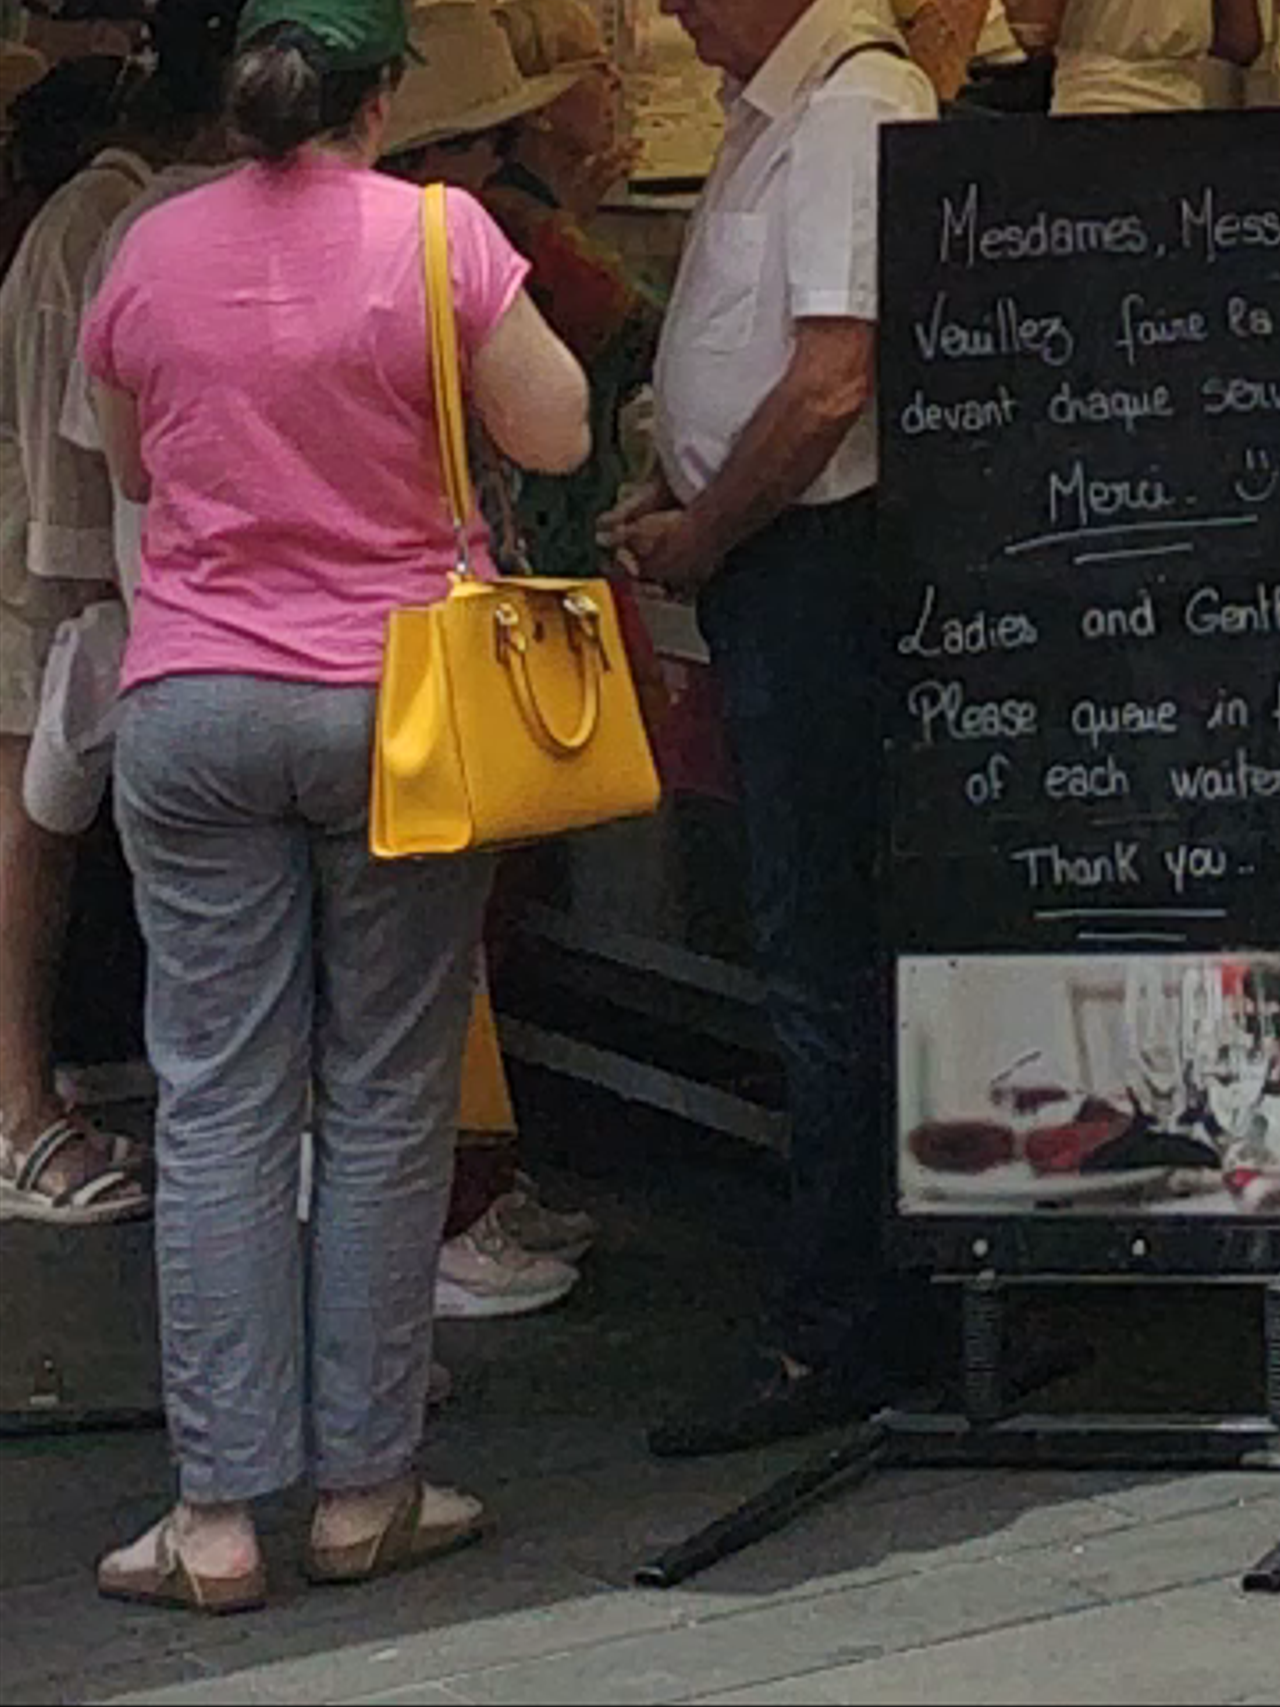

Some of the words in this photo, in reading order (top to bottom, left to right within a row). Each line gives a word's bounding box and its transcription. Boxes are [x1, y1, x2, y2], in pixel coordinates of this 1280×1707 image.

[915, 291, 1074, 367] Veuillez
[1115, 293, 1209, 366] faire
[1227, 296, 1273, 337] la
[901, 384, 1020, 435] devant
[1048, 382, 1174, 434] chaque
[898, 584, 1038, 657] Ladies
[1081, 588, 1156, 638] and
[907, 680, 1037, 746] Please
[1071, 699, 1178, 748] queue
[1207, 688, 1249, 729] in
[964, 753, 1010, 804] of
[1045, 756, 1130, 799] each
[1009, 840, 1141, 887] Thank
